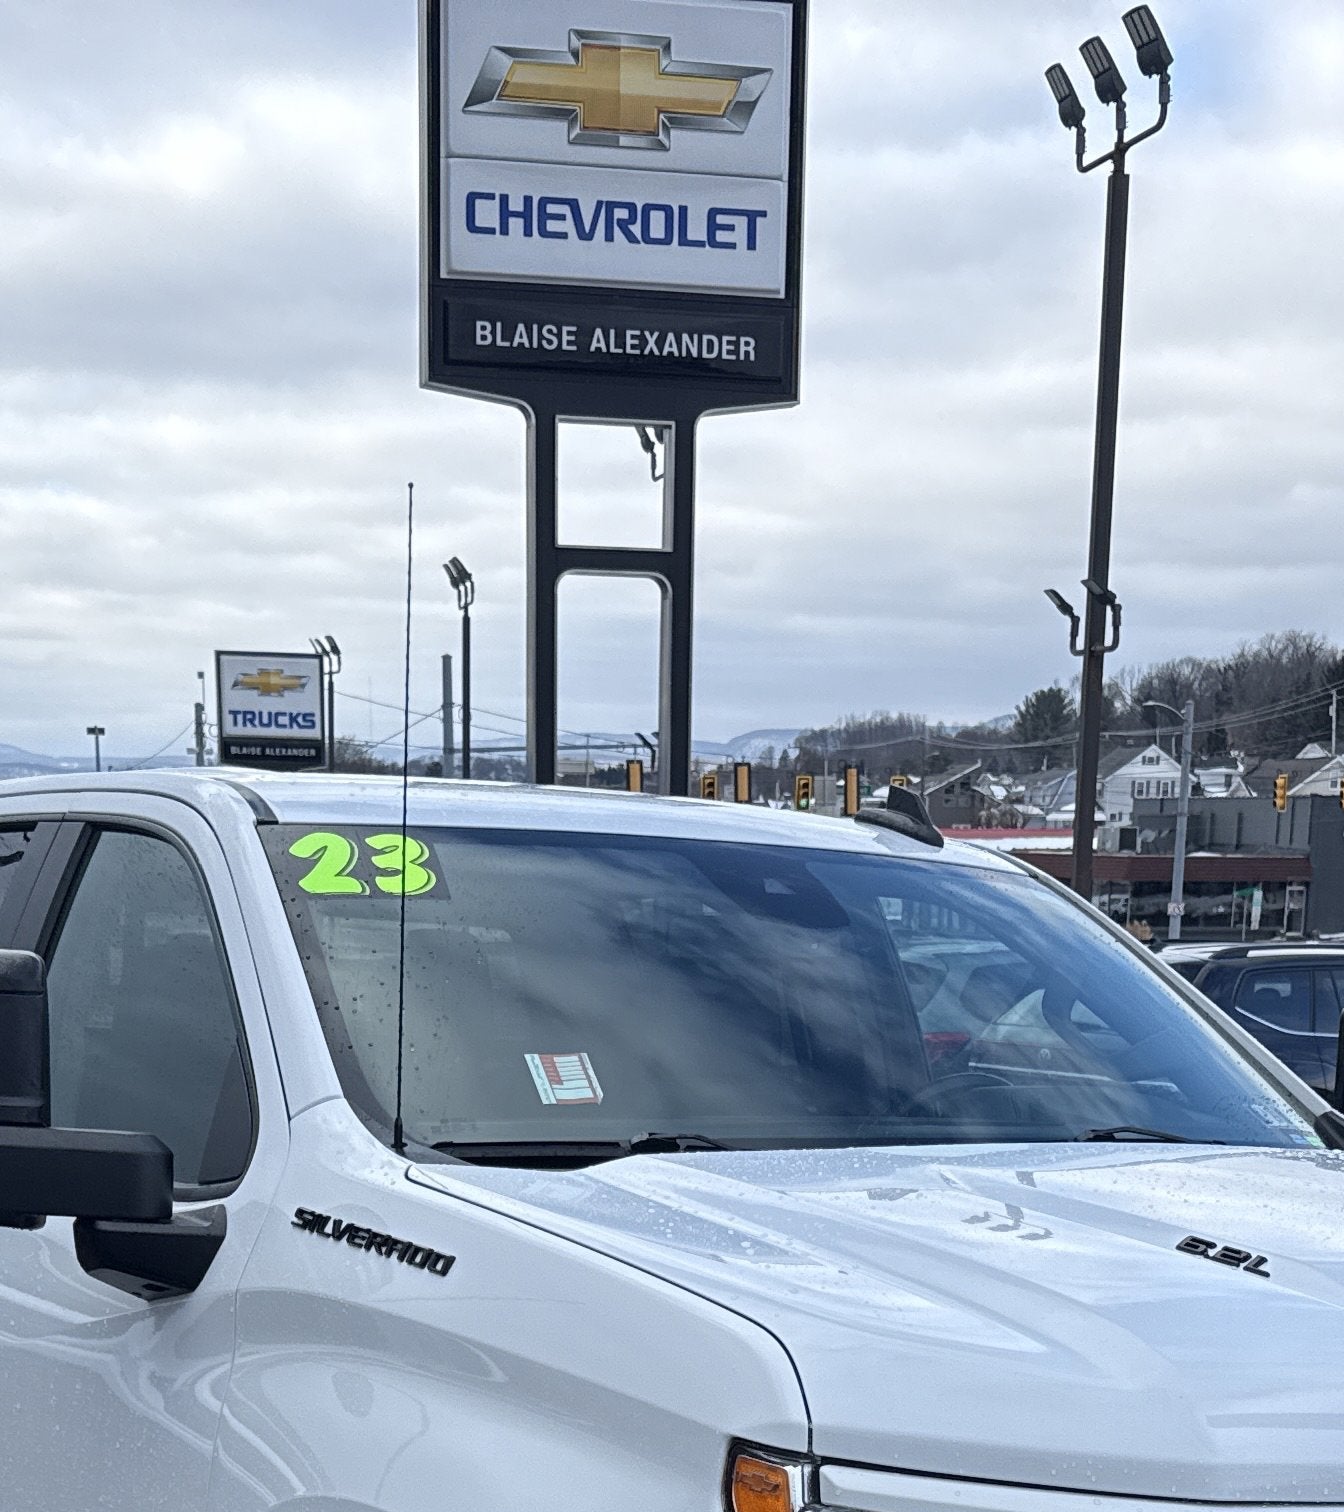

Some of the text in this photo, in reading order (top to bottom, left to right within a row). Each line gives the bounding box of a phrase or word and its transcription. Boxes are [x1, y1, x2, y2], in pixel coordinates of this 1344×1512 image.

[465, 191, 767, 251] CHEVROLET
[475, 320, 756, 361] BLAISE ALEXANDER
[228, 709, 316, 729] TRUCKS
[288, 832, 436, 896] 23
[291, 1206, 456, 1276] SILVERADO
